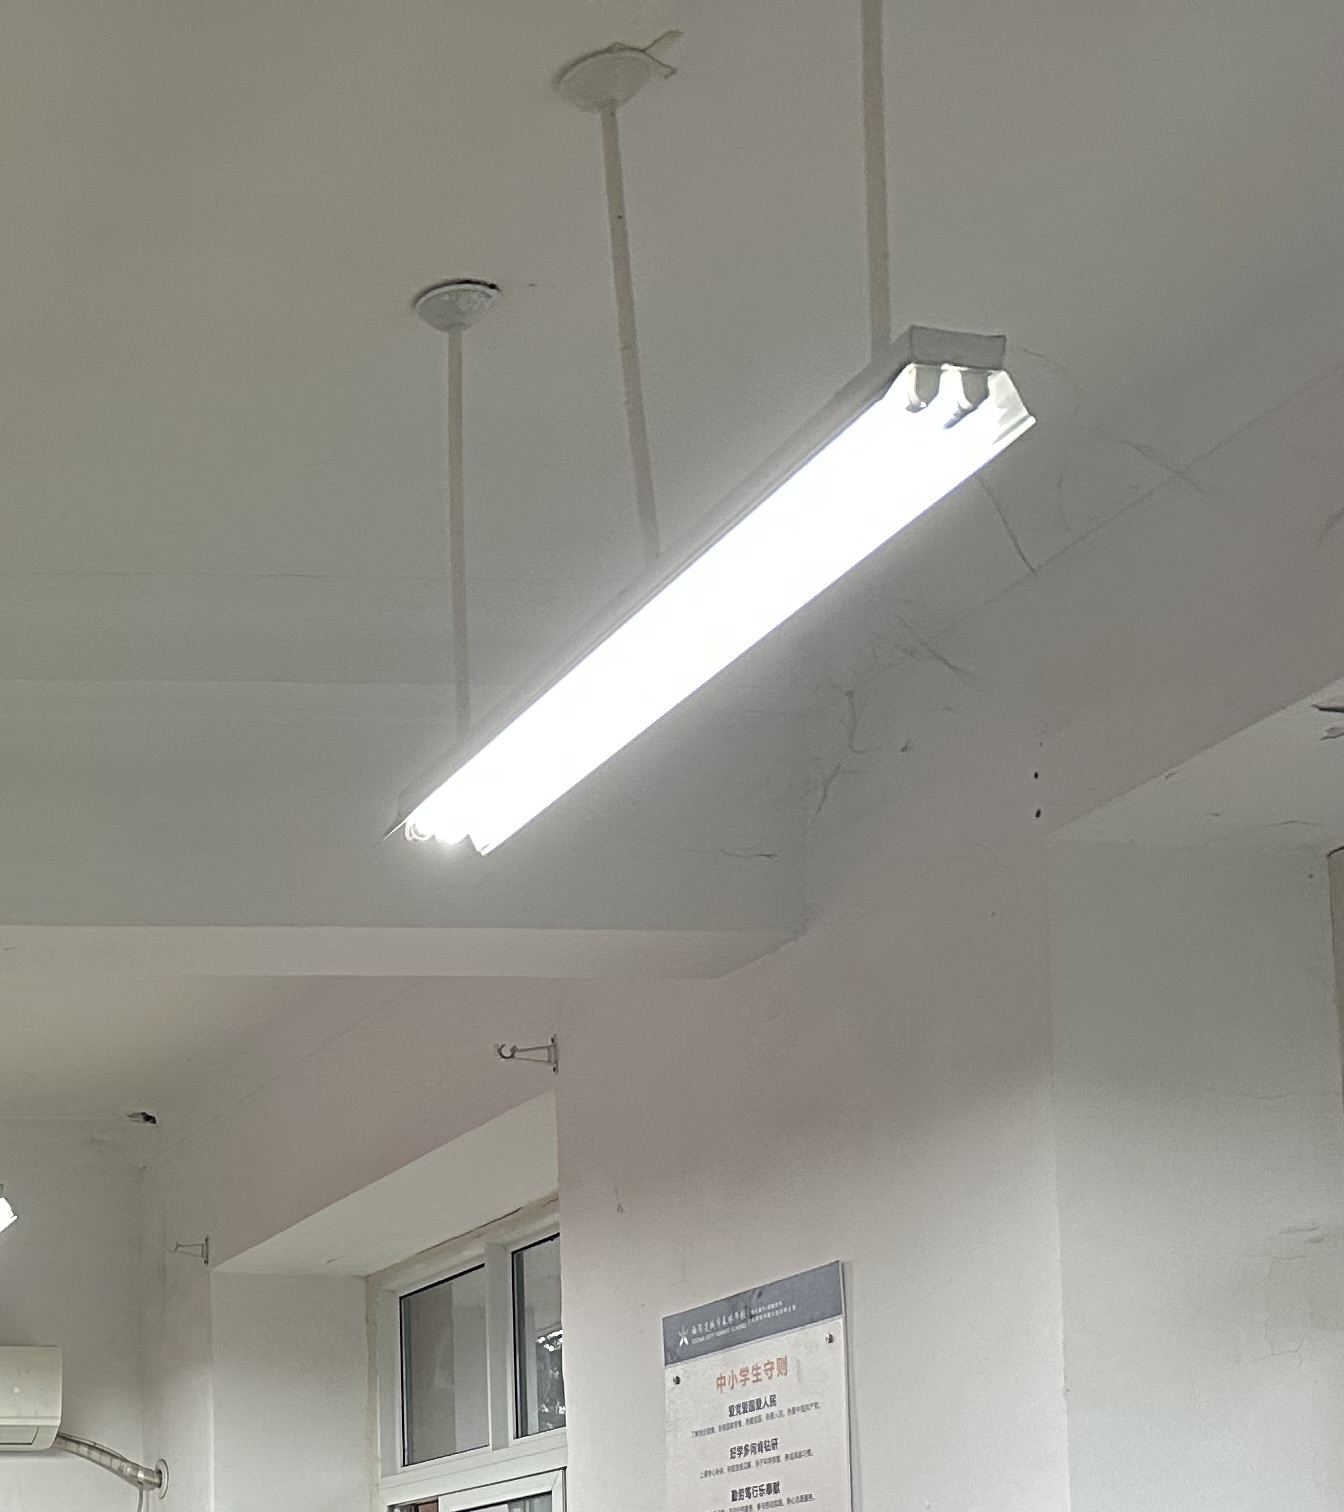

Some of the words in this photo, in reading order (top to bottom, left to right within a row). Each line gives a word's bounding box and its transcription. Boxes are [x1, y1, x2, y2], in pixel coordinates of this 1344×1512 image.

[716, 1355, 788, 1392] 中小学生守则
